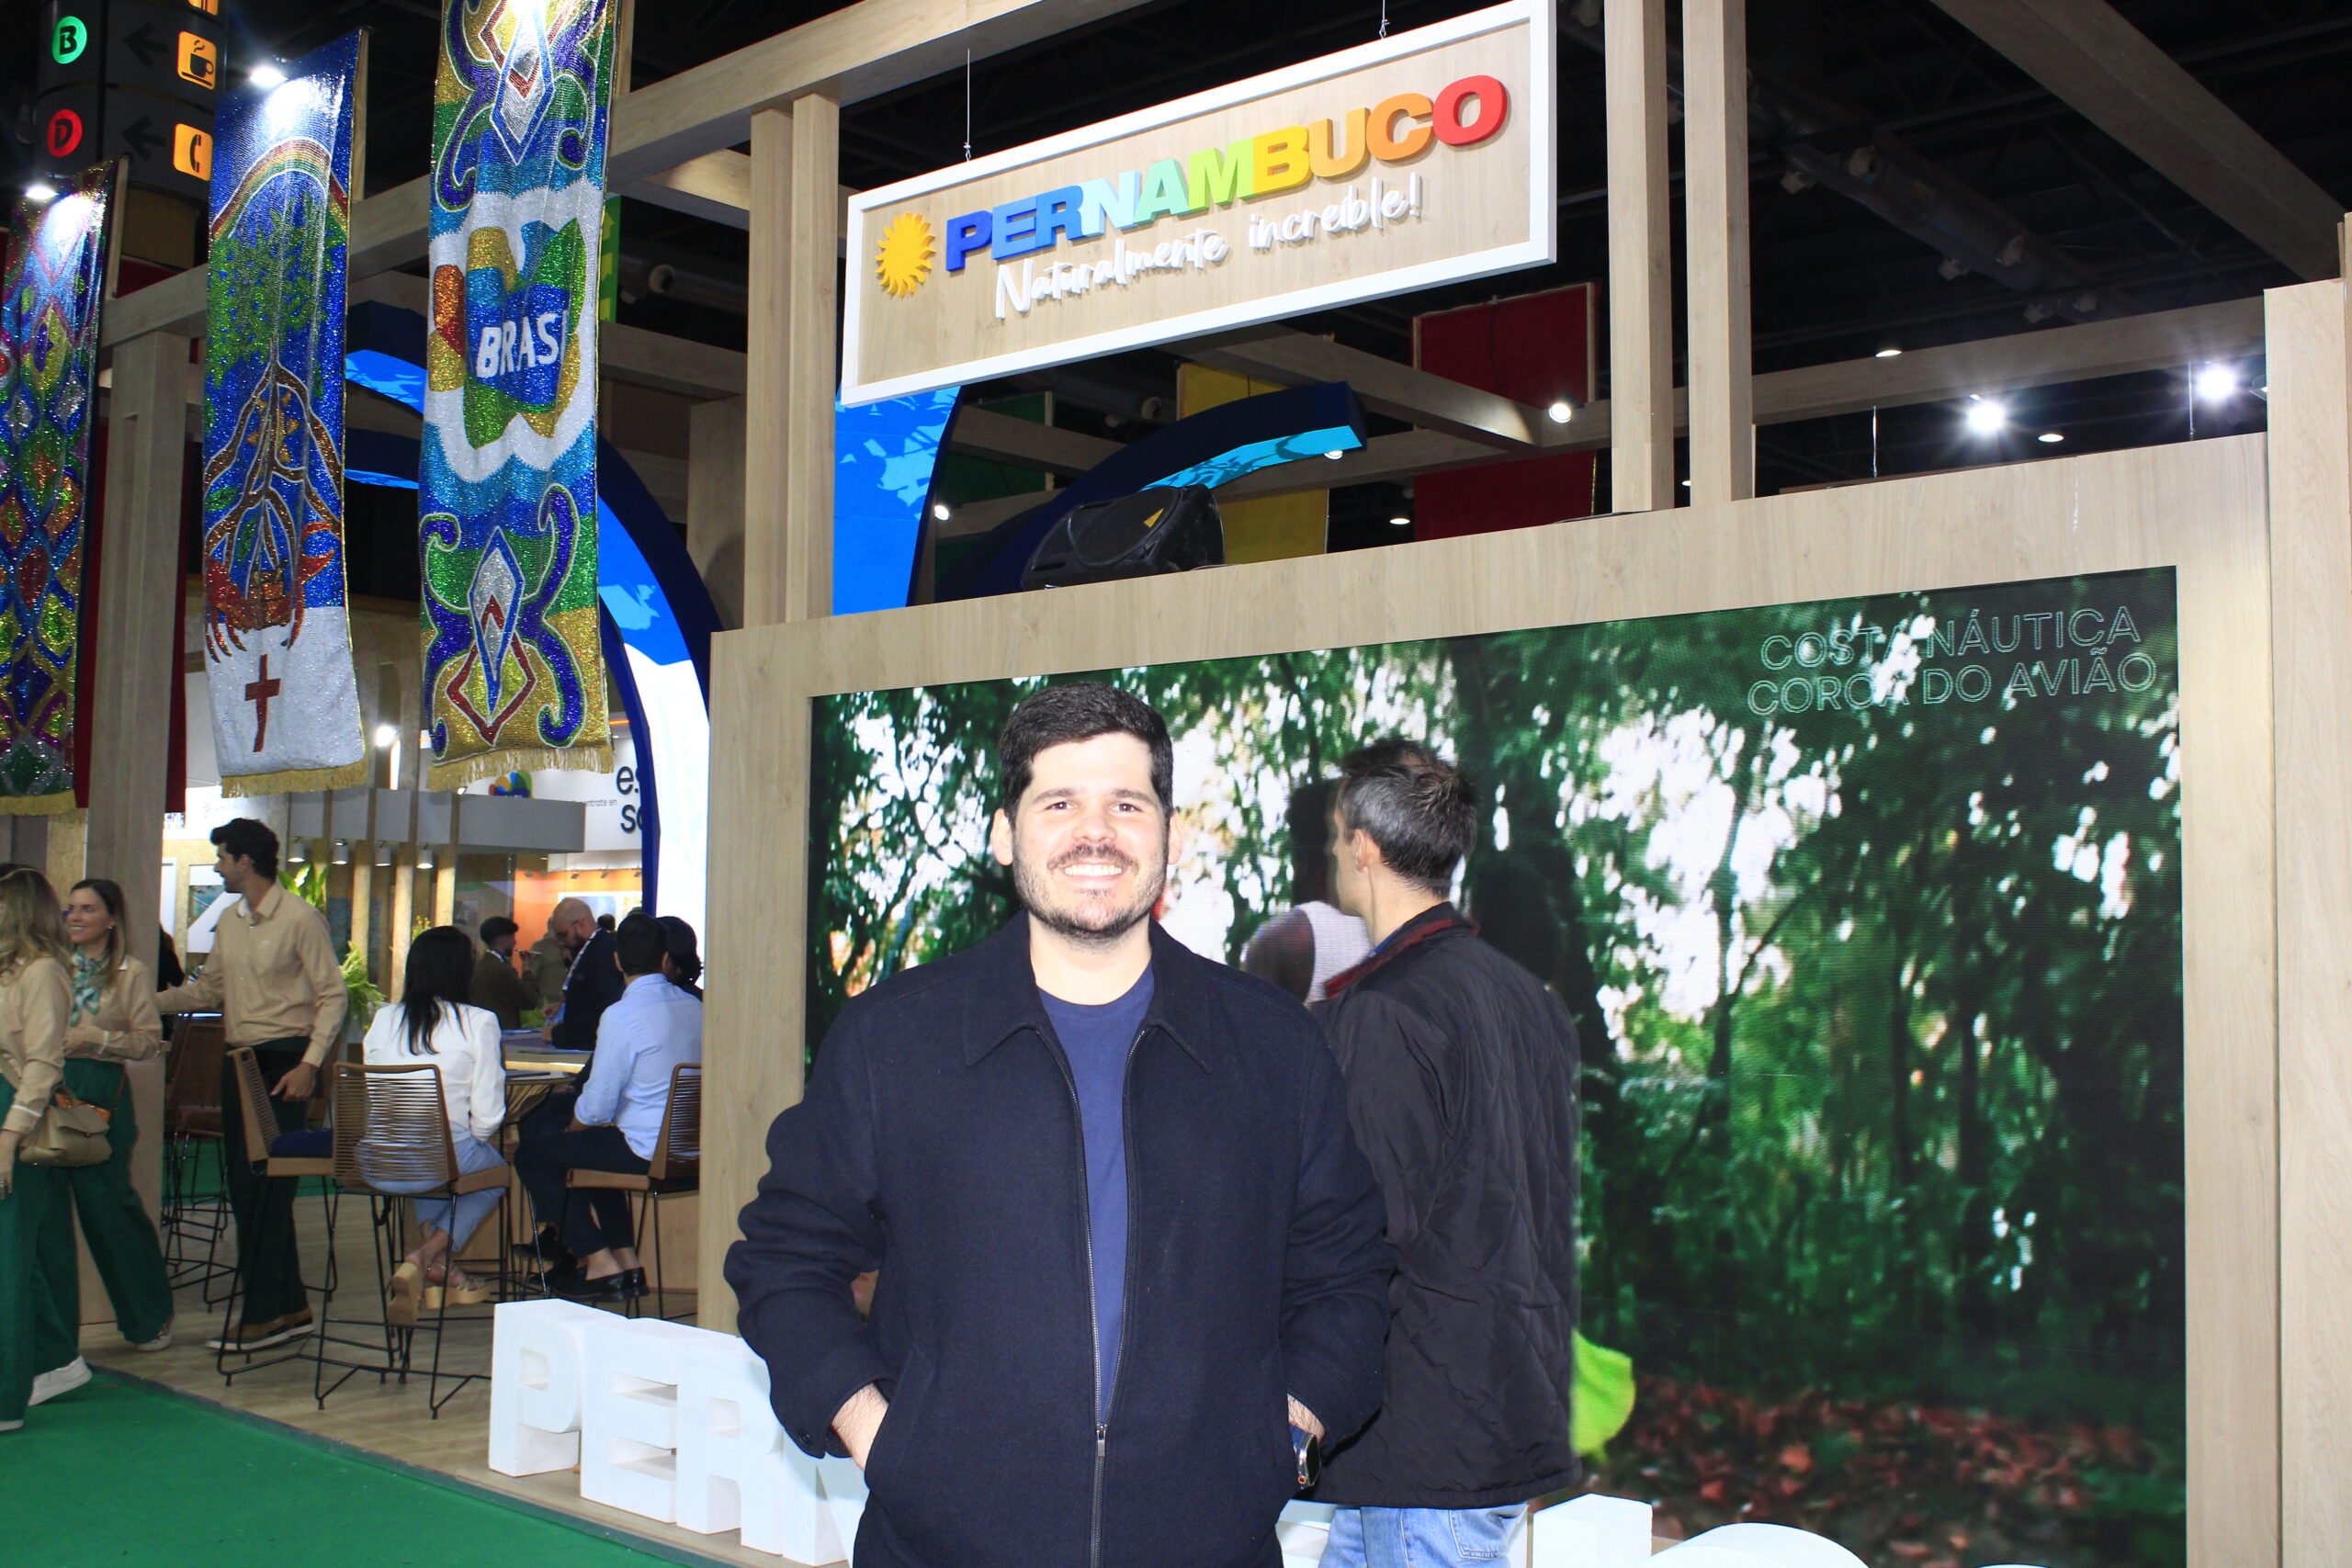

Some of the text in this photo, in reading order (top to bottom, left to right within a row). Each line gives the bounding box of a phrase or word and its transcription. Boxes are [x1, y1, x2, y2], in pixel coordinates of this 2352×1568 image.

[59, 26, 78, 56] B
[54, 118, 74, 150] D
[945, 75, 1508, 272] PERNAMBUCO
[995, 228, 1230, 319] Naturalmente
[1926, 605, 2142, 659] NÁUTICA
[1923, 664, 1992, 705] DO
[2003, 647, 2157, 698] AVIÃO
